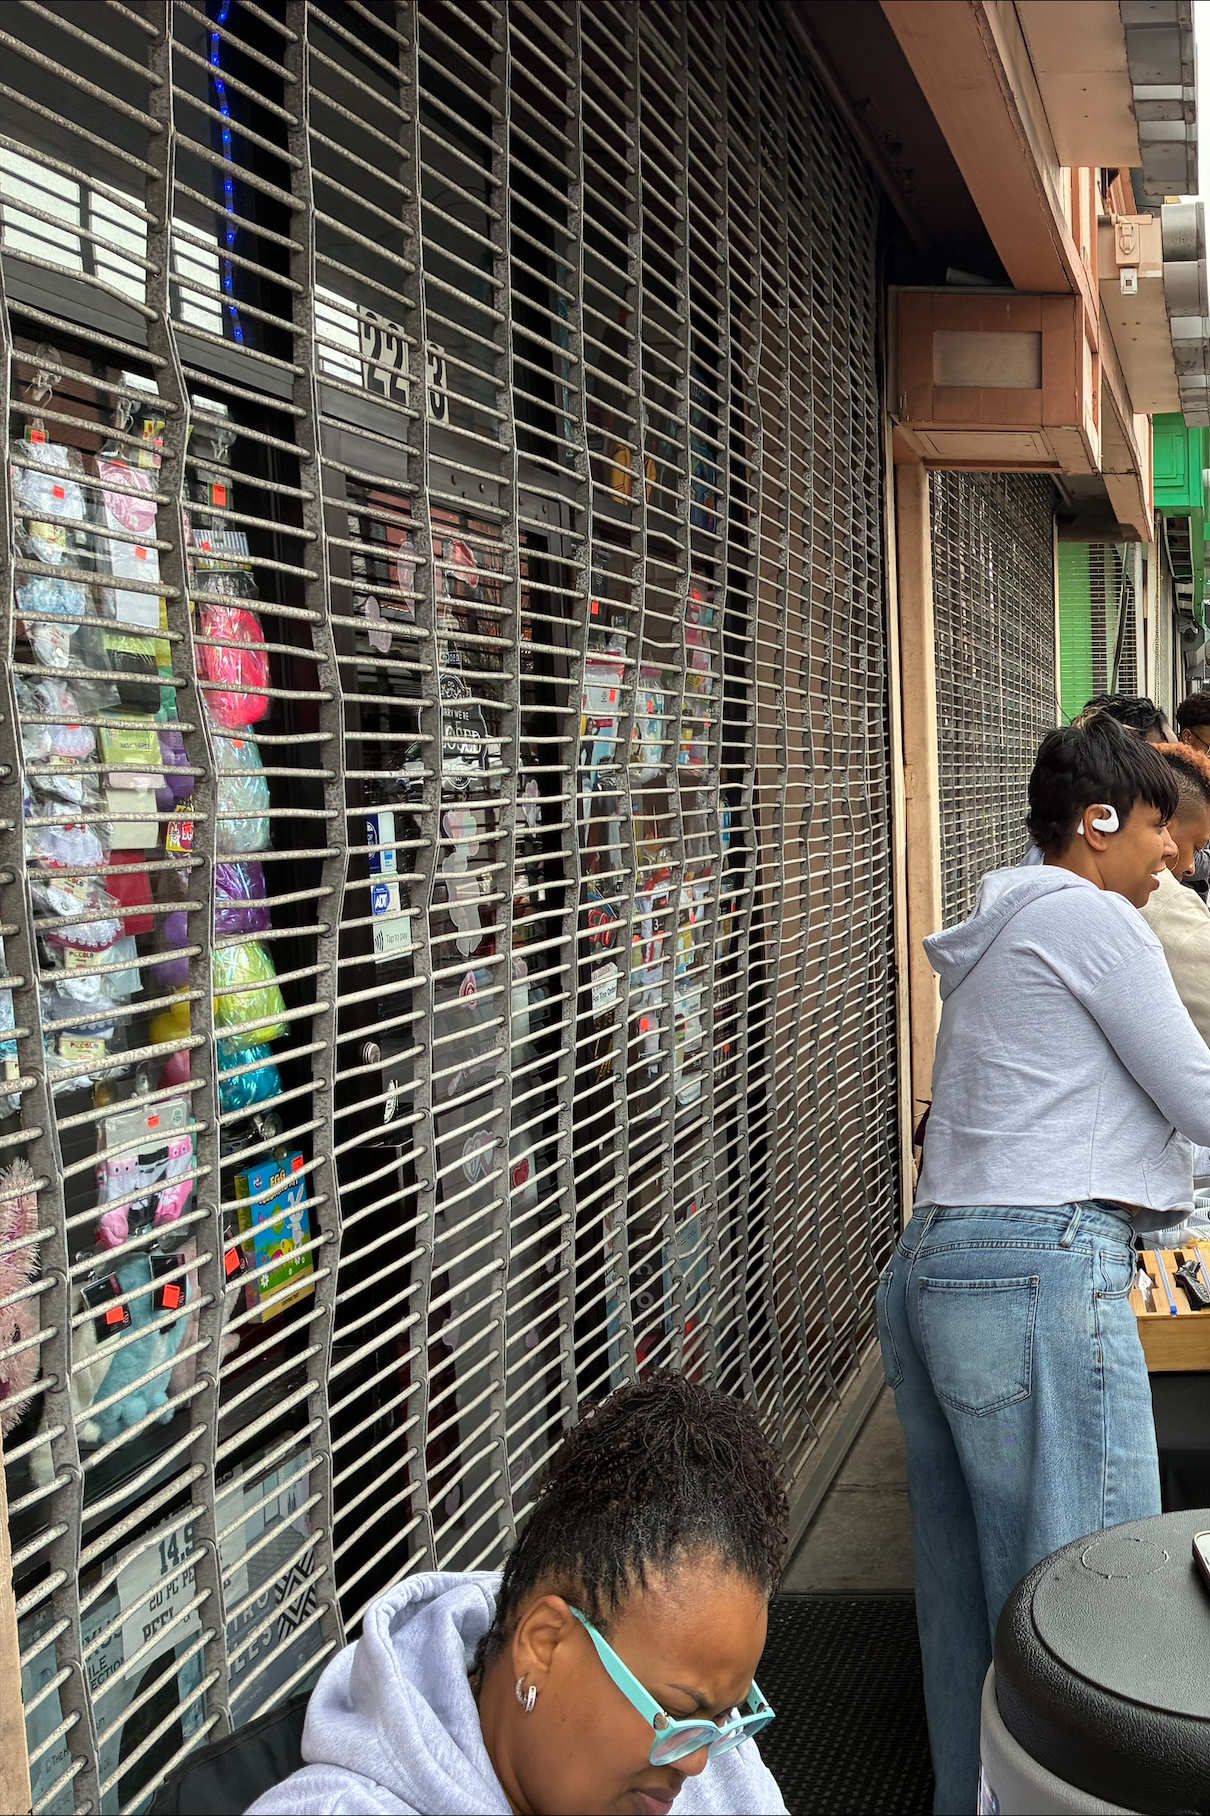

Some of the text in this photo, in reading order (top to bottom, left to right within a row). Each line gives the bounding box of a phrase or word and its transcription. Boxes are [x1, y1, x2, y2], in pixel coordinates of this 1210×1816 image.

[375, 894, 388, 909] ADT
[386, 933, 395, 944] Tap
[400, 930, 408, 942] pay
